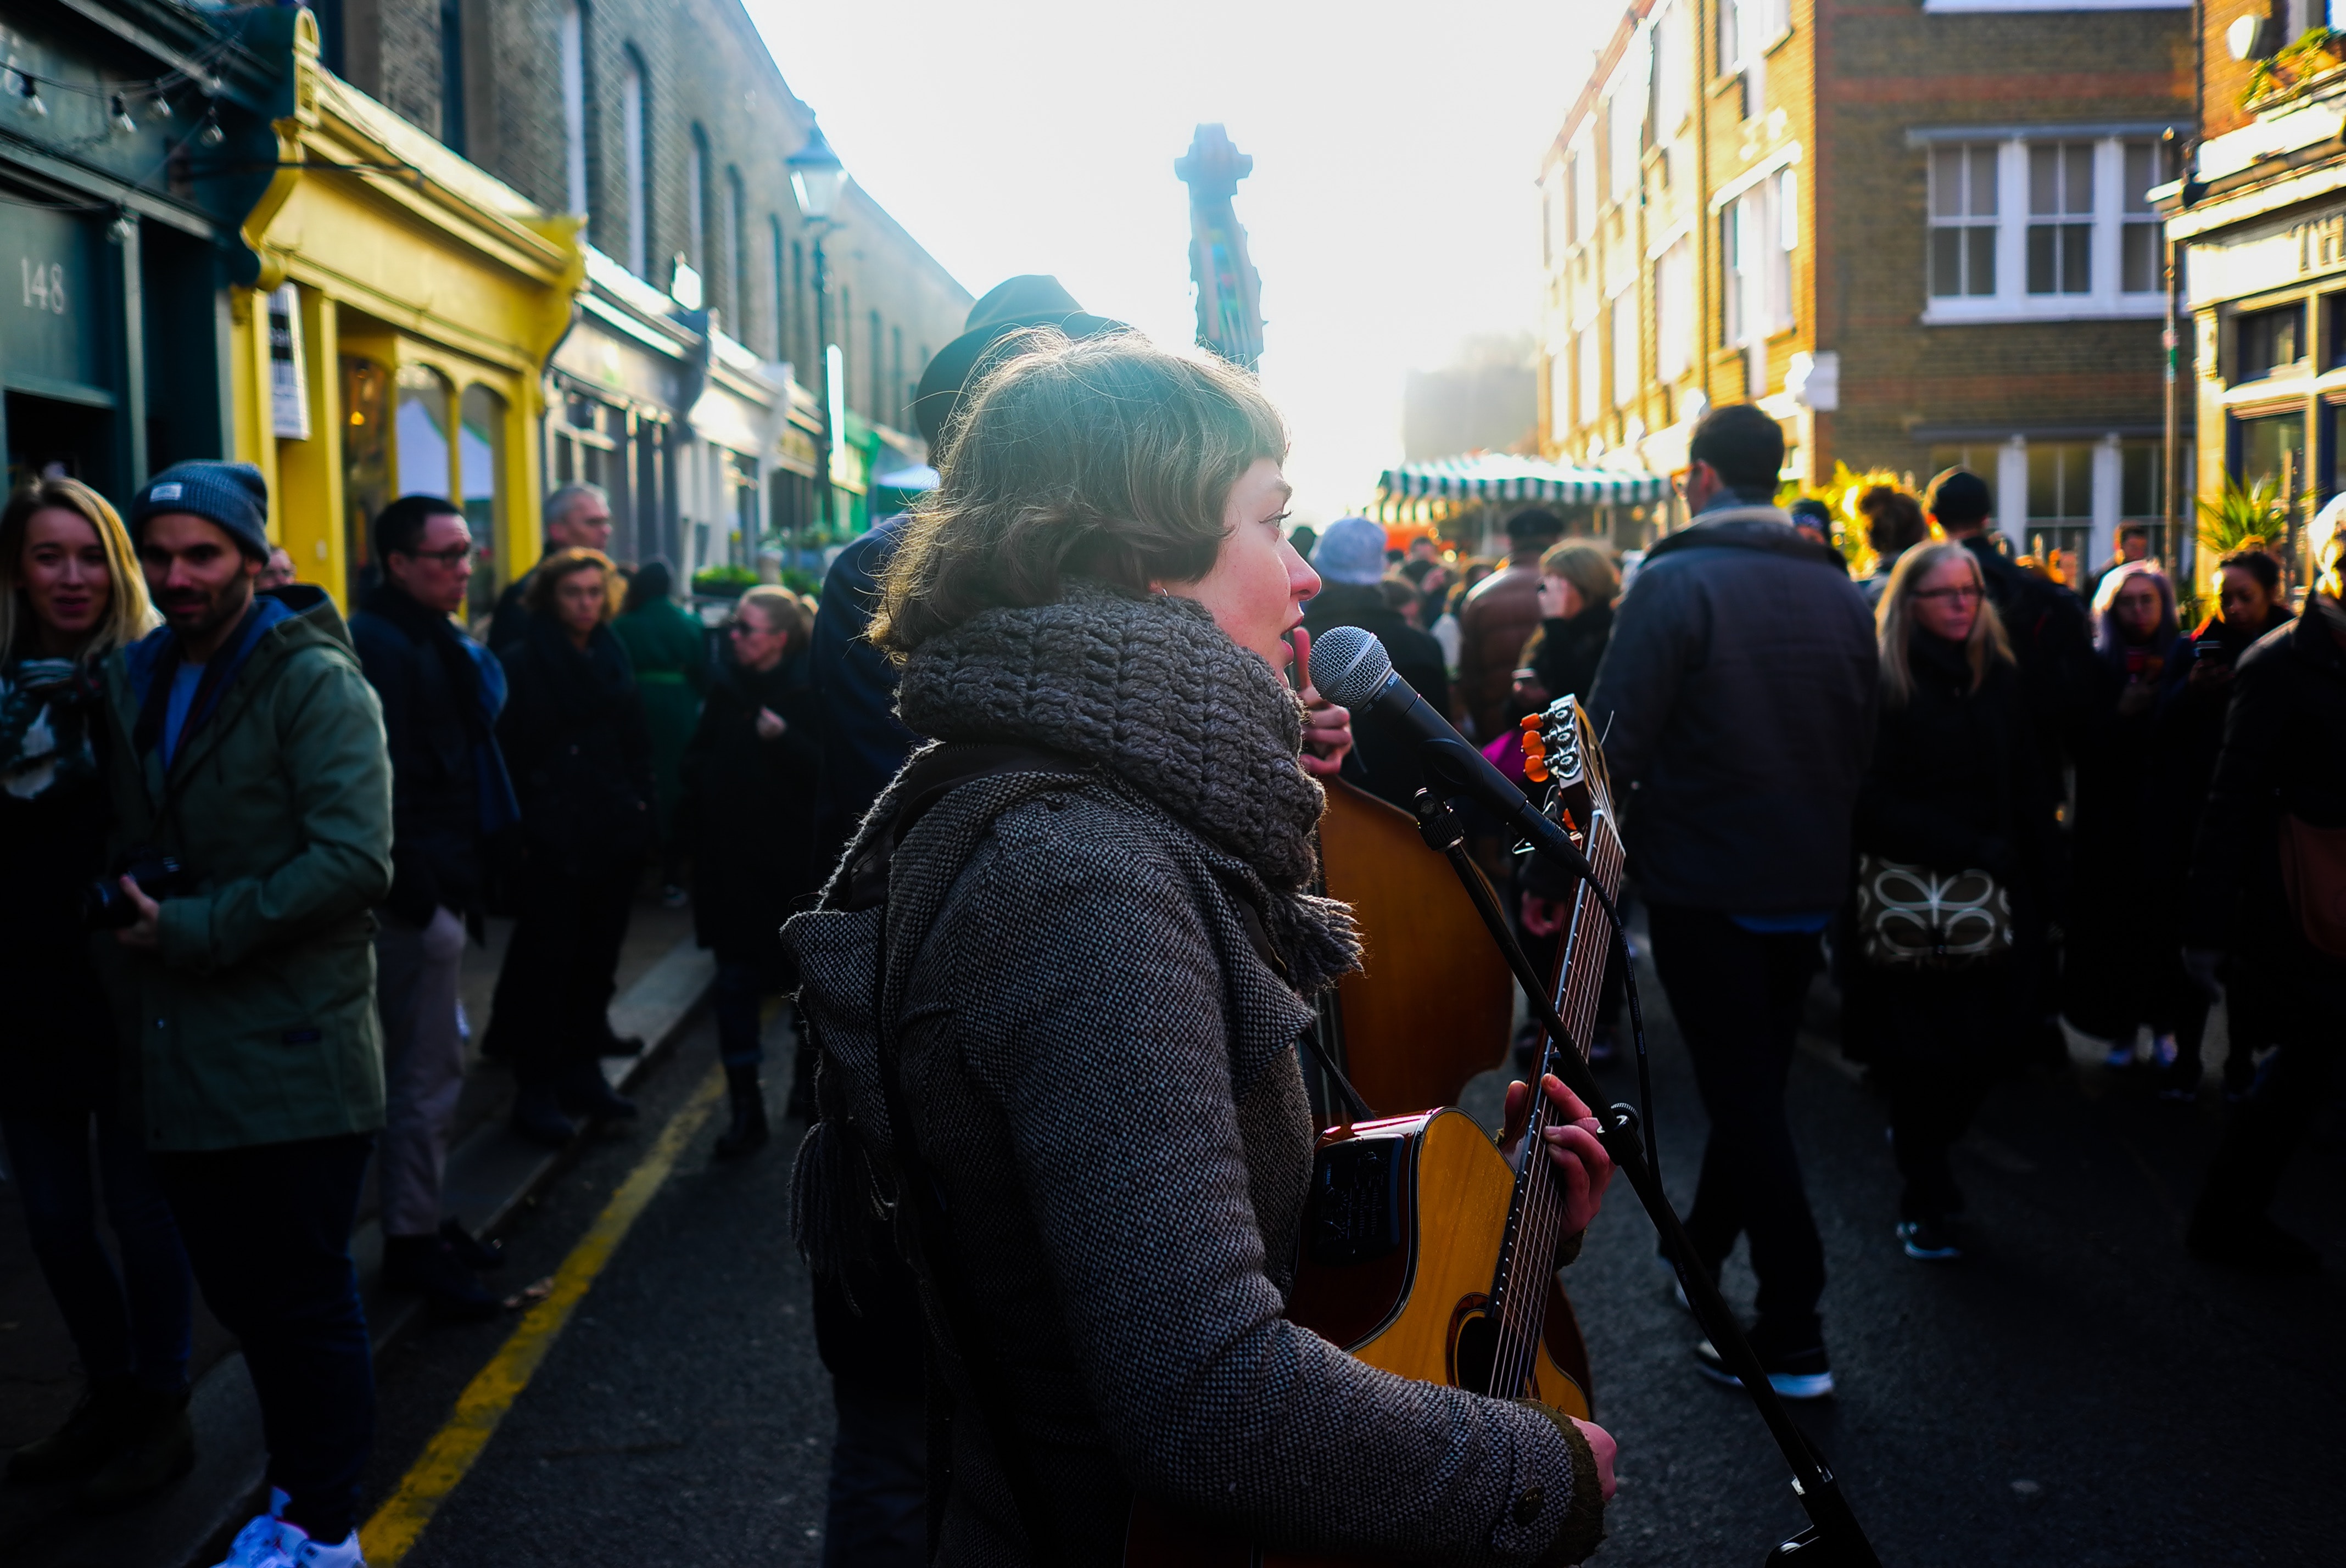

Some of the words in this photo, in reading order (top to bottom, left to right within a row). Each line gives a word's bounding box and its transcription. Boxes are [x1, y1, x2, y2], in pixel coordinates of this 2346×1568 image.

[21, 257, 65, 315] 148
[1374, 688, 1387, 702] SM58
[1624, 949, 1634, 982] MICROPHONE
